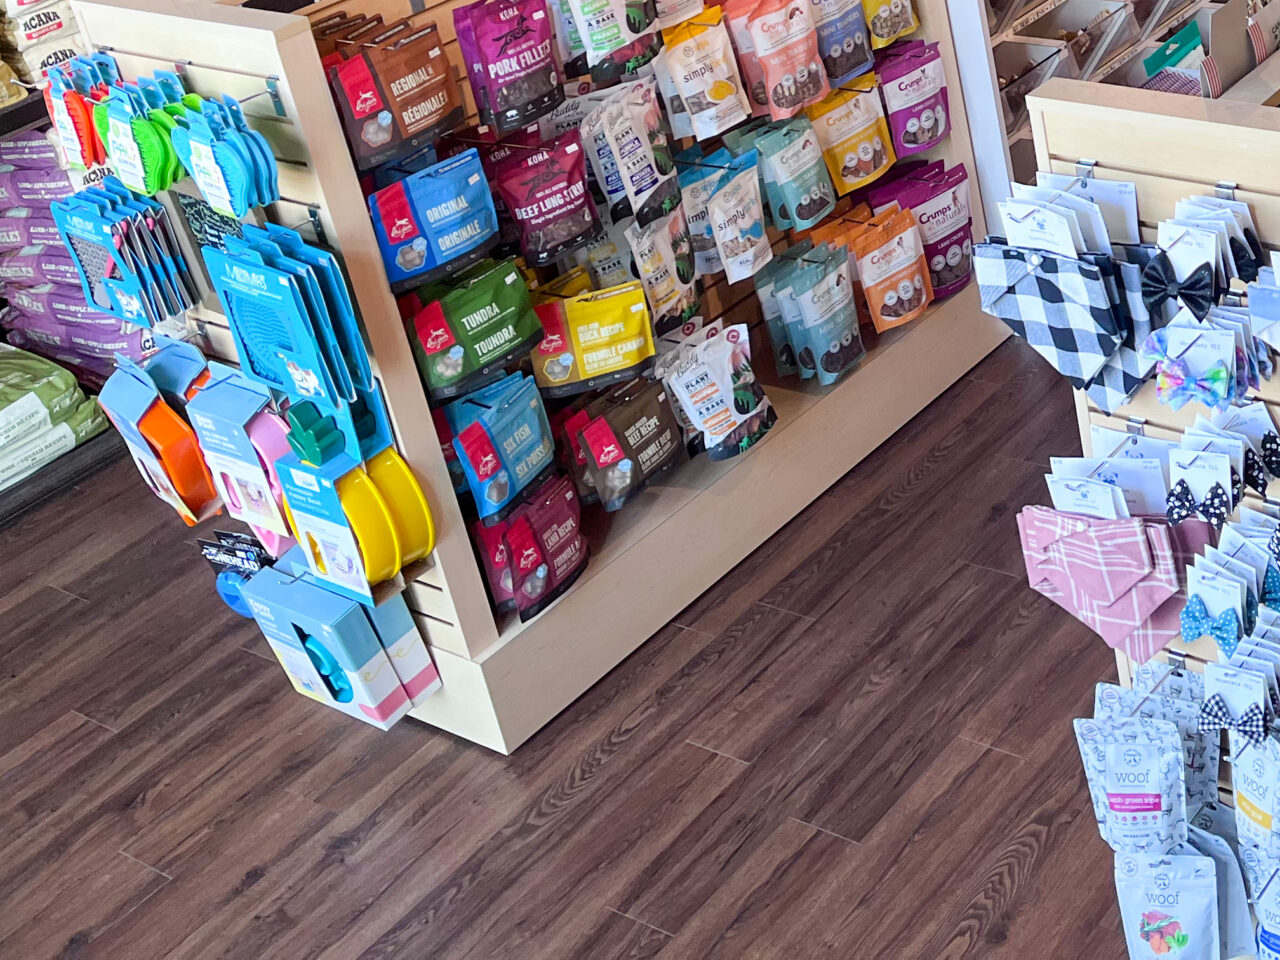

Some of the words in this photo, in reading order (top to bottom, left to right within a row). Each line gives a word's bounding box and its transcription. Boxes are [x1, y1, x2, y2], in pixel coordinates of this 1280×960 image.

[23, 10, 61, 32] ACANA
[499, 6, 519, 22] KOHA
[596, 13, 616, 25] BASE
[40, 48, 77, 70] ACANA
[488, 56, 521, 79] PORK
[518, 38, 551, 69] FILLETS
[390, 66, 431, 97] REGIONAL
[402, 92, 446, 126] RÉGIONALE
[526, 151, 550, 167] KOHA
[426, 194, 469, 224] ORIGINAL
[514, 203, 540, 220] BEEF
[539, 194, 564, 213] LUNG
[438, 219, 481, 252] ORIGINALE
[460, 302, 500, 328] TUNDRA
[473, 325, 517, 357] TOUNDRA
[580, 330, 600, 342] DUCK
[600, 322, 625, 337] RECIPE
[684, 373, 710, 390] PLANT
[502, 436, 515, 453] SIX
[514, 424, 532, 446] FISH
[627, 430, 641, 446] BEEF
[640, 416, 660, 437] RECIPE
[544, 531, 560, 550] LAMB
[558, 516, 576, 538] RECIPE
[1115, 770, 1151, 784] woof
[1242, 774, 1269, 800] woof
[1124, 797, 1144, 806] green
[1146, 890, 1181, 906] woof
